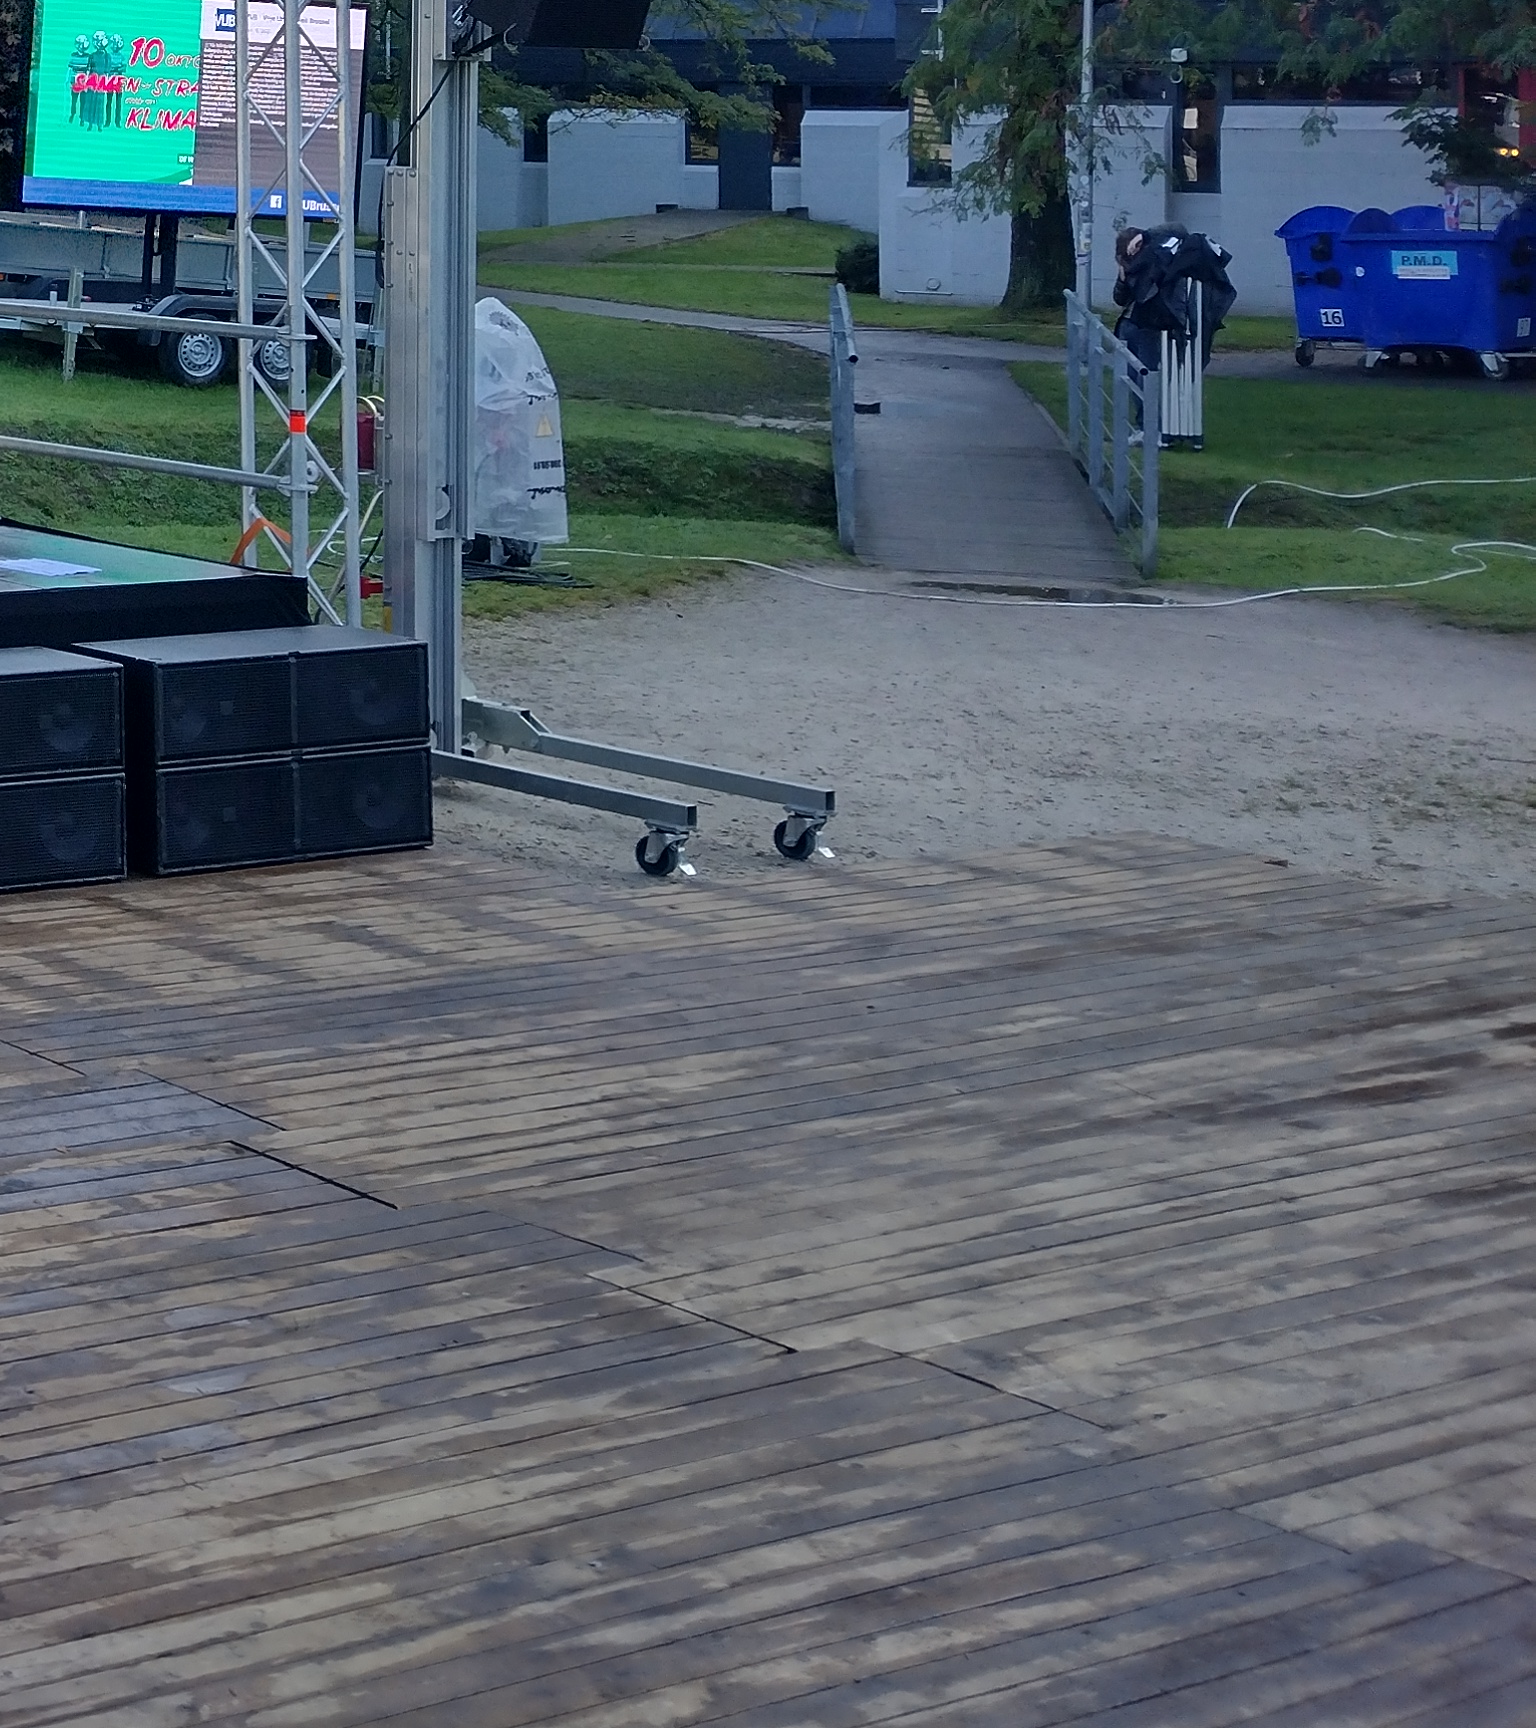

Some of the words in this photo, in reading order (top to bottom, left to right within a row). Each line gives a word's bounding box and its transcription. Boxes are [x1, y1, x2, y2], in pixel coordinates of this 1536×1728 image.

[129, 36, 165, 68] 10
[72, 72, 141, 94] SAMEN
[302, 199, 340, 212] UBrus
[1401, 255, 1448, 266] P.M.D.
[1322, 310, 1342, 325] 16
